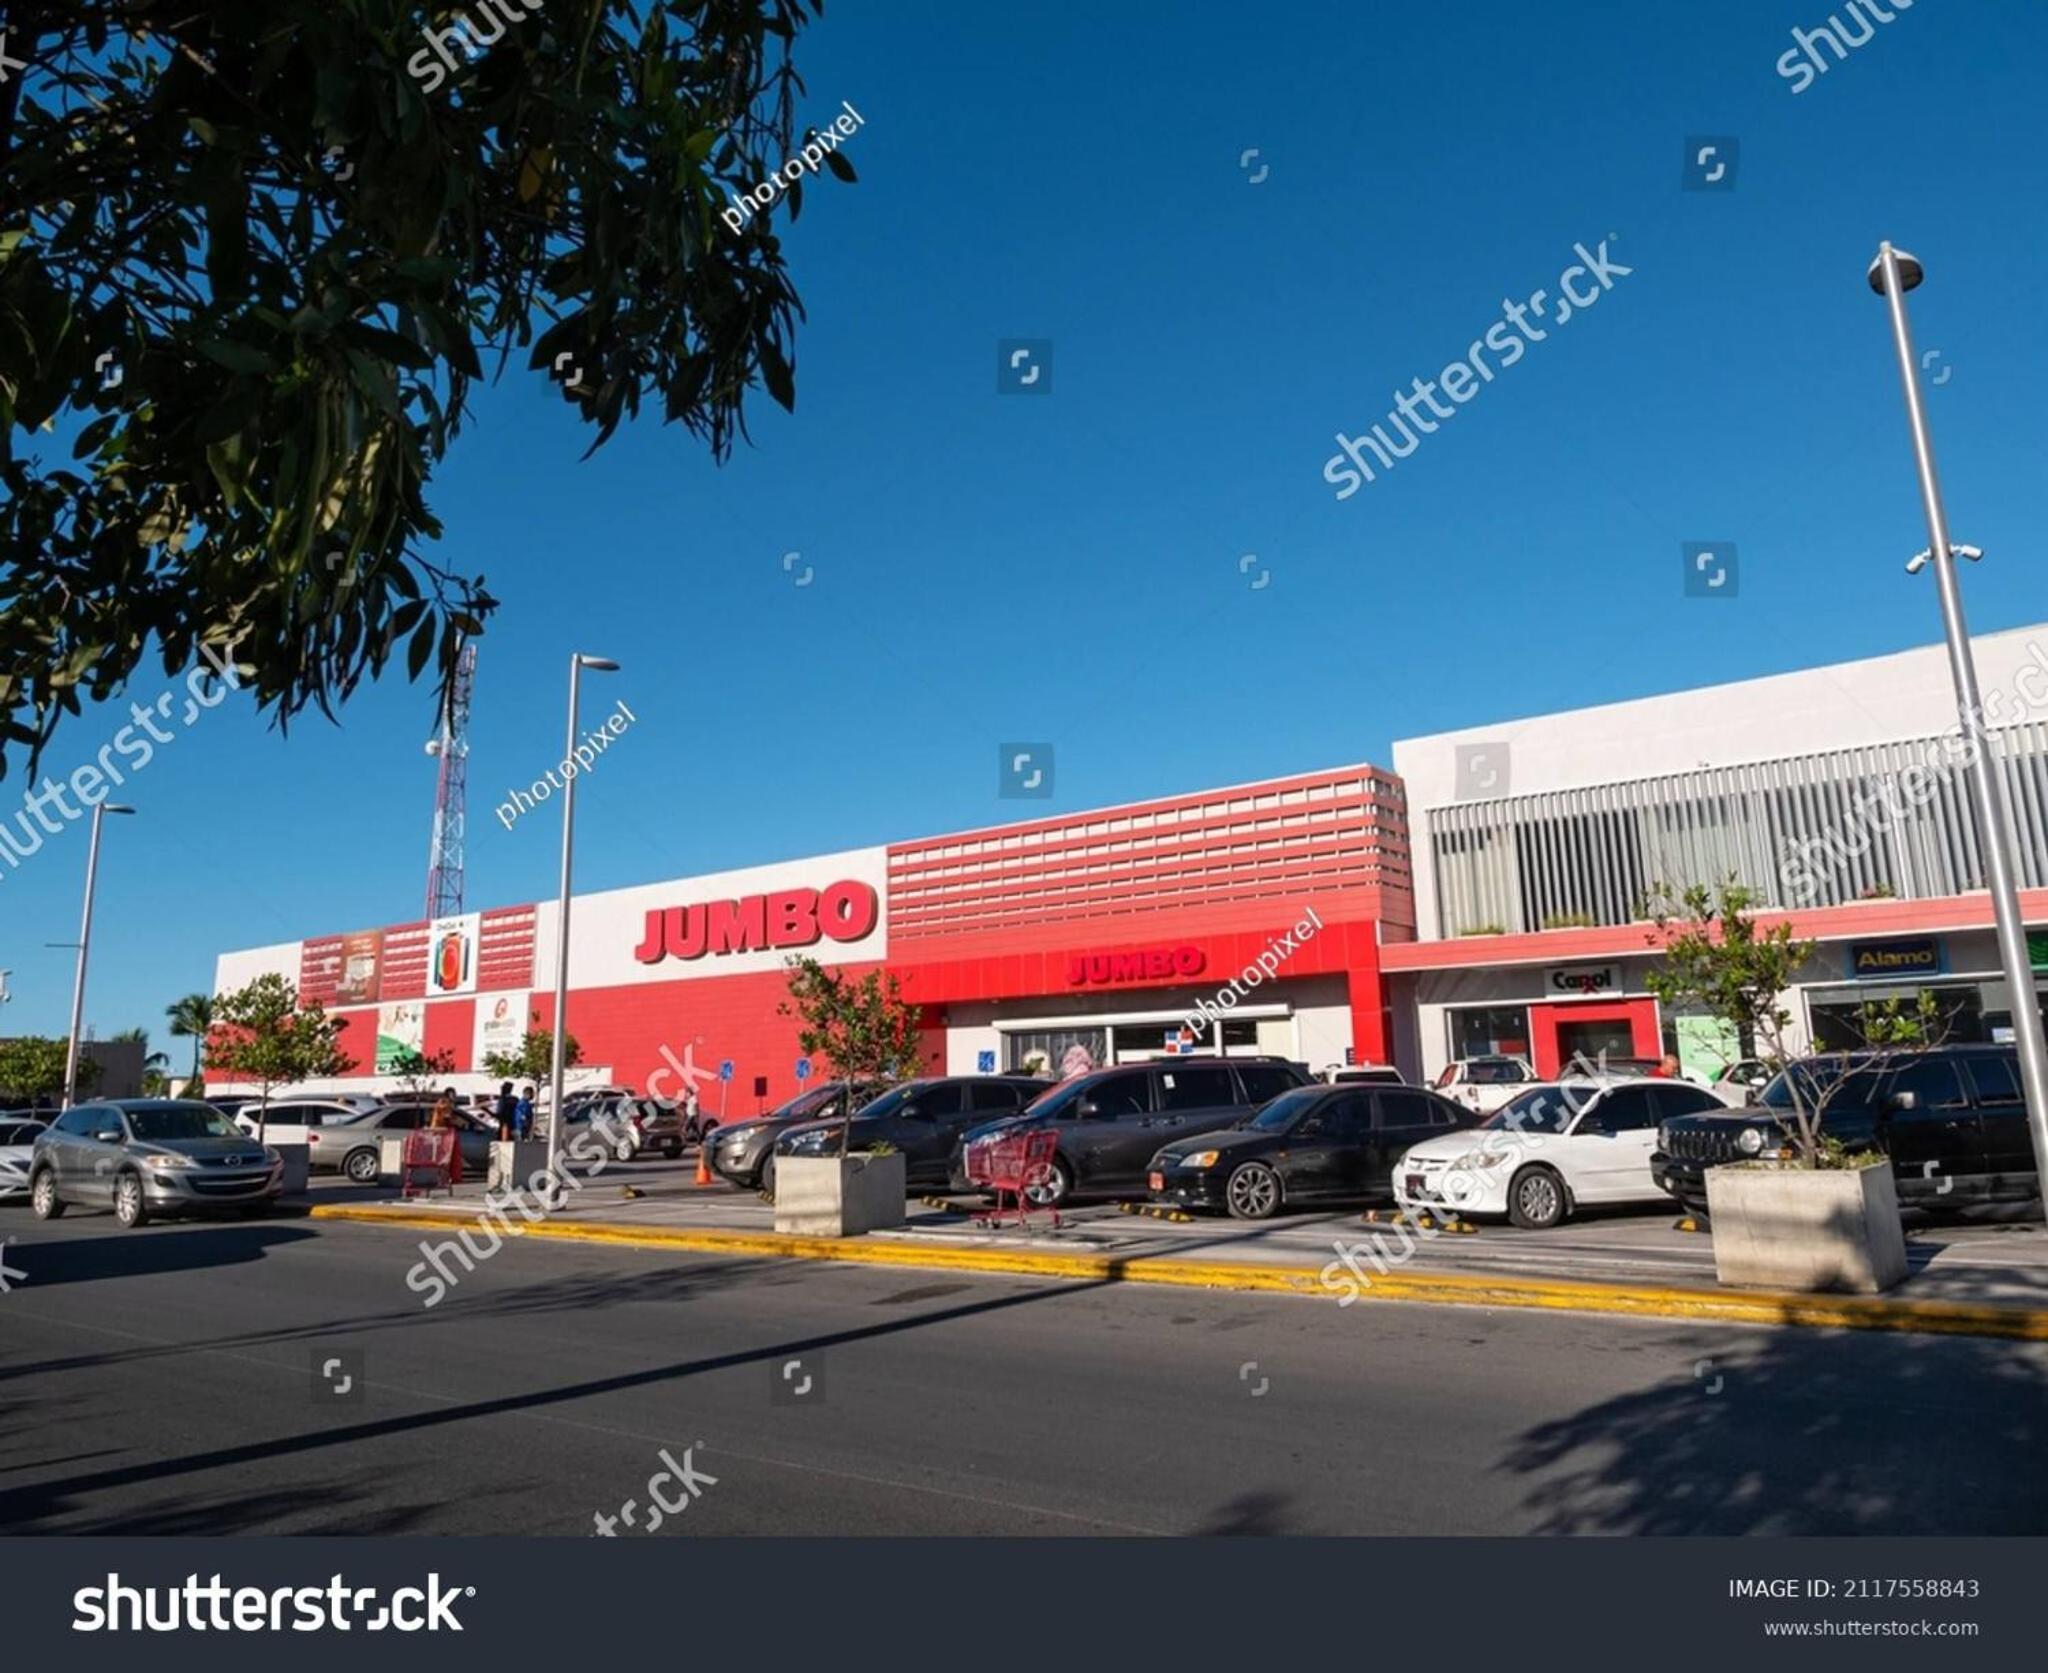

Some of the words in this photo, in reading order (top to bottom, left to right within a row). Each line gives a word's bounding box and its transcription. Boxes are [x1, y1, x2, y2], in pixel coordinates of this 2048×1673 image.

[635, 879, 878, 965] JUMBO
[1067, 946, 1206, 985] JUMBO
[1857, 950, 1932, 968] Alamo
